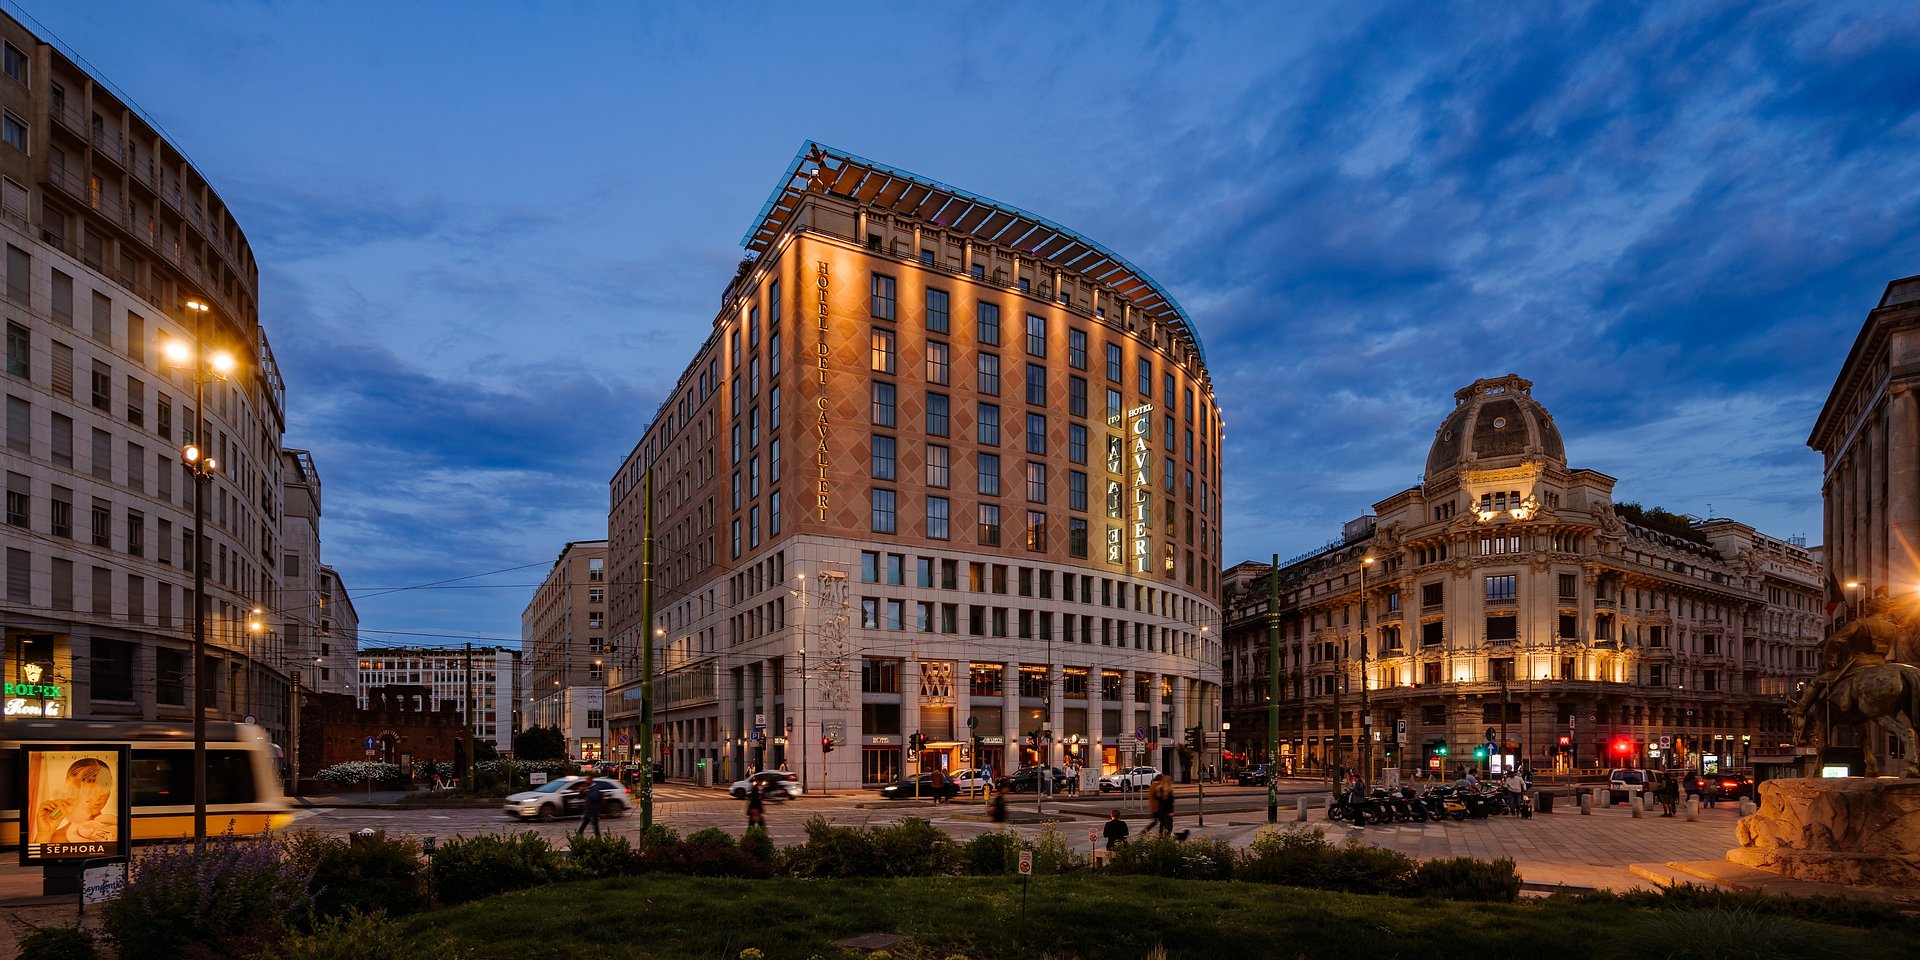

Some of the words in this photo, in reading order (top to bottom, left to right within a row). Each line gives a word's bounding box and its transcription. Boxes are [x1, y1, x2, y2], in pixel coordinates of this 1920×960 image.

[817, 260, 829, 332] HOTEL
[817, 342, 829, 385] DEI
[1128, 403, 1154, 418] HOTEL
[817, 397, 829, 522] CAVALIERI
[1133, 418, 1148, 573] CAVALIERI
[46, 844, 105, 855] SEPHORA
